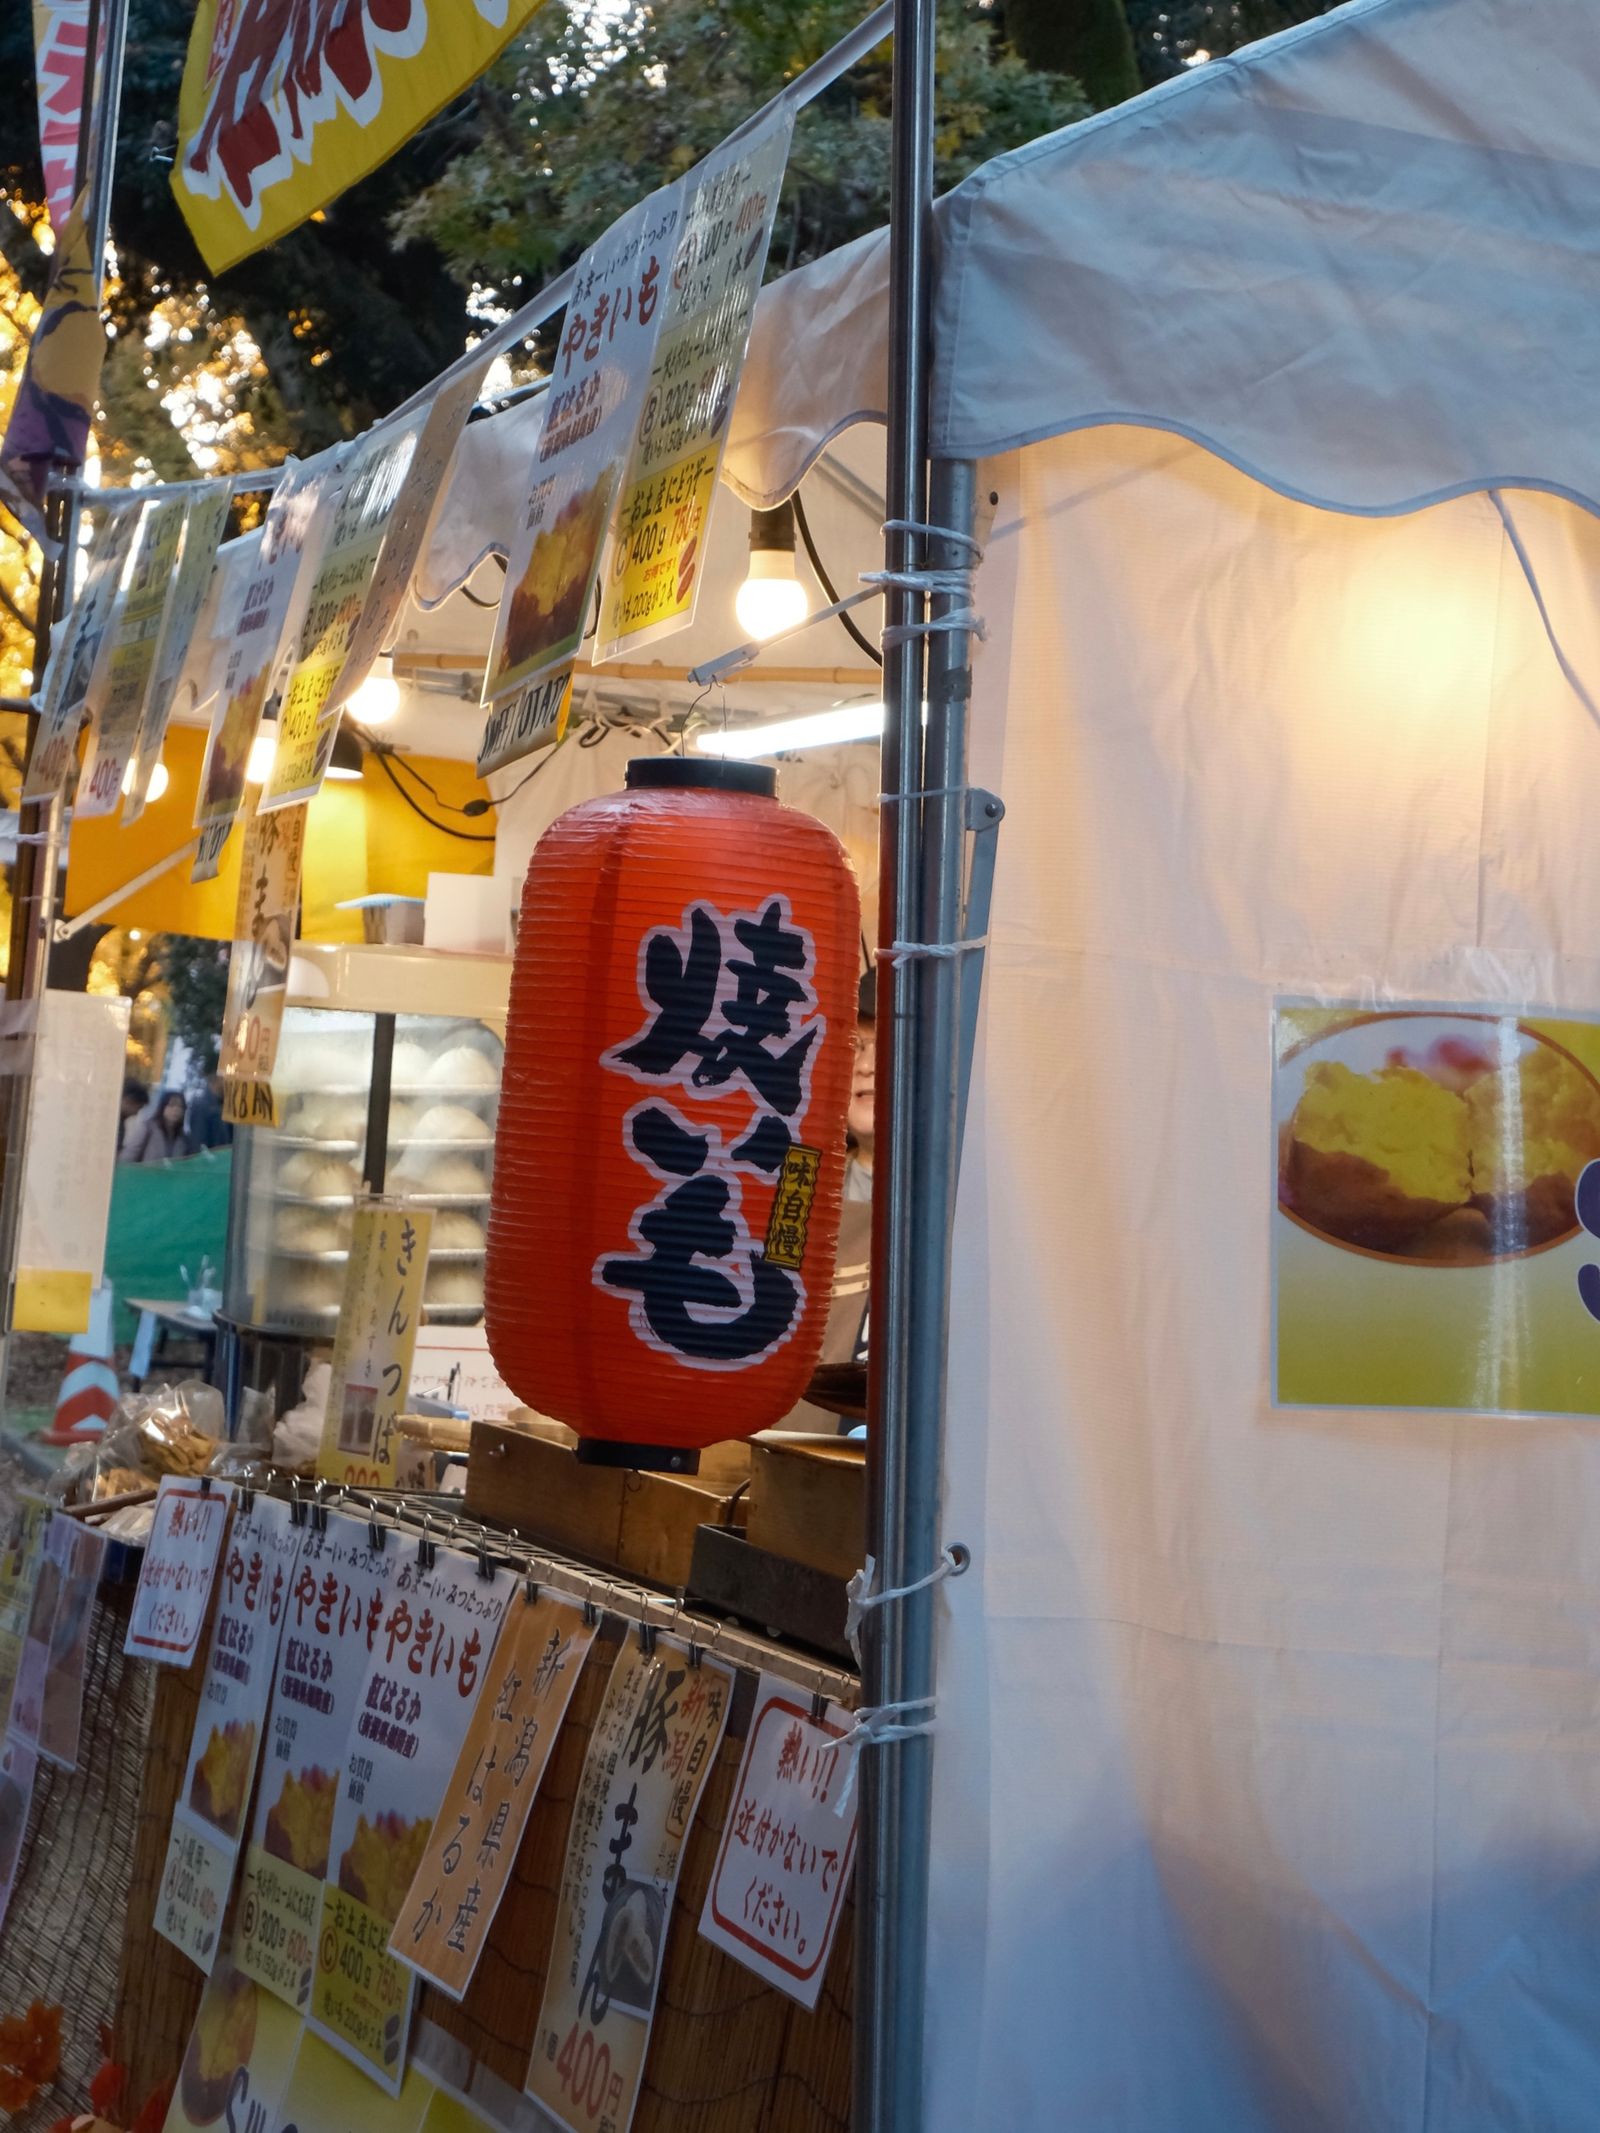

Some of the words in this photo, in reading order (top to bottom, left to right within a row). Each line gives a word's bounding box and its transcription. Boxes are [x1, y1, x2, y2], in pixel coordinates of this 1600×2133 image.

[561, 254, 661, 380] やきいも
[597, 896, 823, 1369] 焼いも
[774, 1156, 811, 1259] 味自慢
[373, 1219, 417, 1464] きんつば
[226, 1546, 283, 1626] やきいも
[295, 1565, 383, 1653] やきいも
[365, 1672, 421, 1725] 紅はるか
[385, 1600, 481, 1697] やきいも
[413, 1660, 521, 1944] 紅はるか
[447, 1627, 571, 1954] 新潟県産
[777, 1720, 840, 1803] 熱い!!
[578, 1661, 687, 2026] 豚まん
[735, 1799, 838, 1893] 近付かないで
[743, 1875, 806, 1955] ください。
[557, 2021, 624, 2121] 400円
